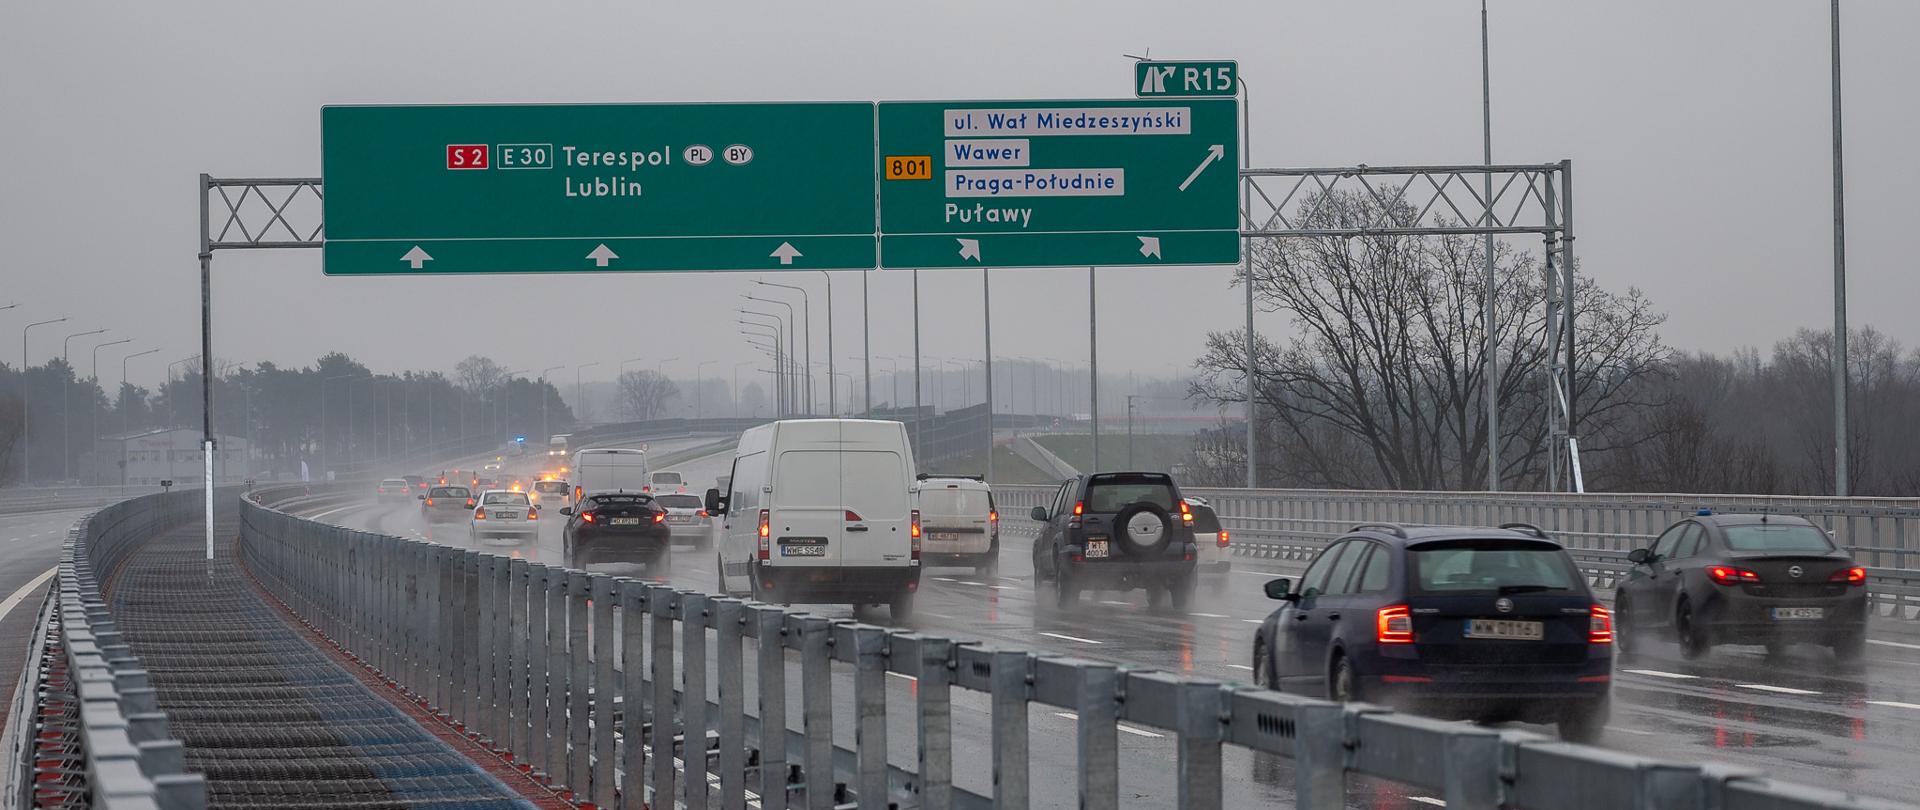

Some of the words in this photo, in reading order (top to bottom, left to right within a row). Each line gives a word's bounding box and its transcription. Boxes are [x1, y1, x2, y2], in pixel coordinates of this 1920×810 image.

[1184, 67, 1232, 91] R15
[954, 112, 978, 130] ul.
[987, 112, 1028, 130] Wał
[1037, 111, 1181, 133] Miedzeszyński
[562, 145, 670, 172] Terespol
[690, 148, 706, 162] PL
[730, 148, 748, 162] BY
[953, 144, 1022, 161] Wawer
[892, 159, 926, 176] 801
[565, 176, 642, 197] Lublin
[955, 173, 1115, 195] Praga-Południe
[945, 202, 1032, 228] Puławy
